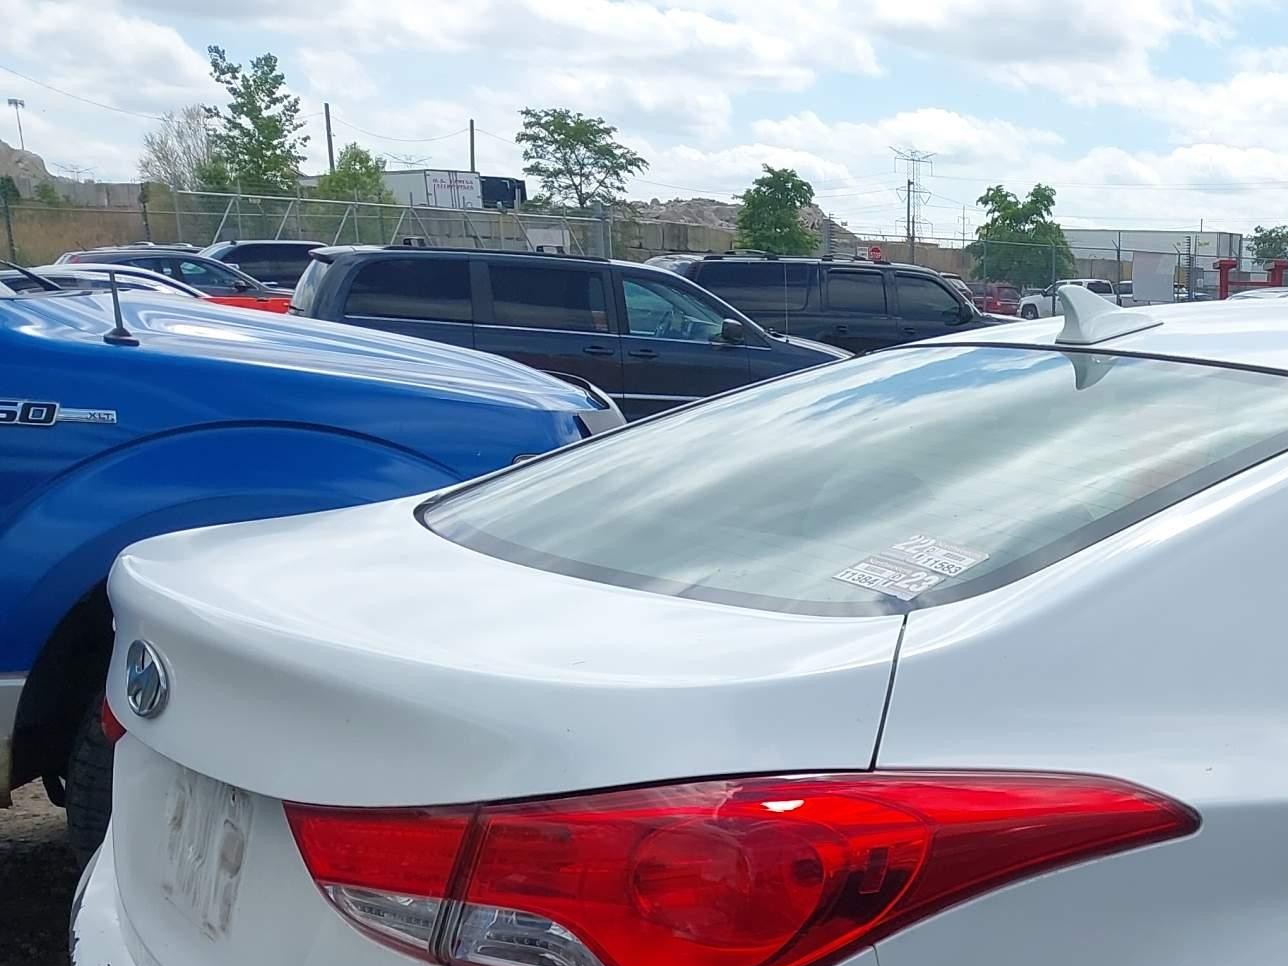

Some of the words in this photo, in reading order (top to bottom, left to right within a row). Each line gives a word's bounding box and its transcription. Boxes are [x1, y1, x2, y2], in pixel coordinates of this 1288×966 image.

[87, 411, 113, 421] XLT
[891, 534, 936, 554] 22
[923, 556, 962, 575] 11583
[840, 570, 879, 586] 11384
[898, 571, 940, 592] 23
